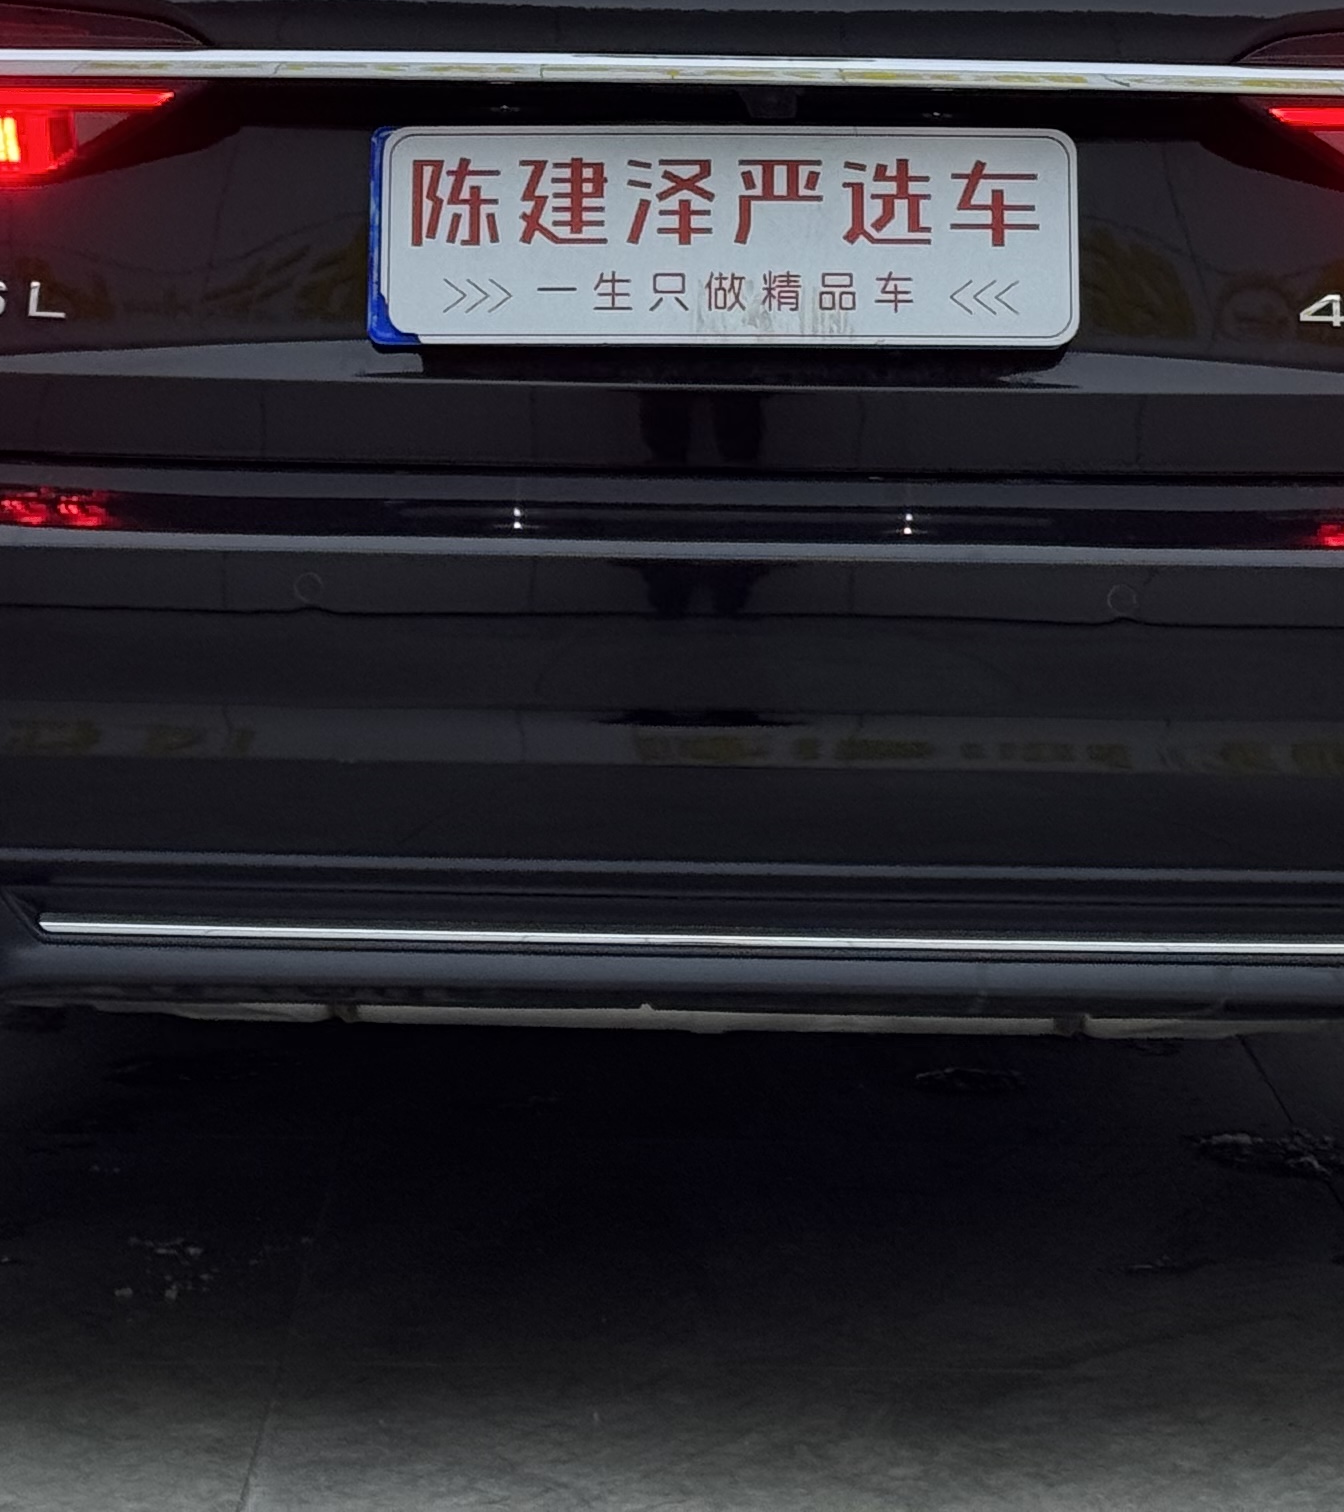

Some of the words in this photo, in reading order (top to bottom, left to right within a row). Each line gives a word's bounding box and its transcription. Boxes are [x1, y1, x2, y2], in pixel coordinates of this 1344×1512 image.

[409, 157, 1041, 248] 陈建泽严选车
[536, 270, 915, 315] 一生只做精品车
